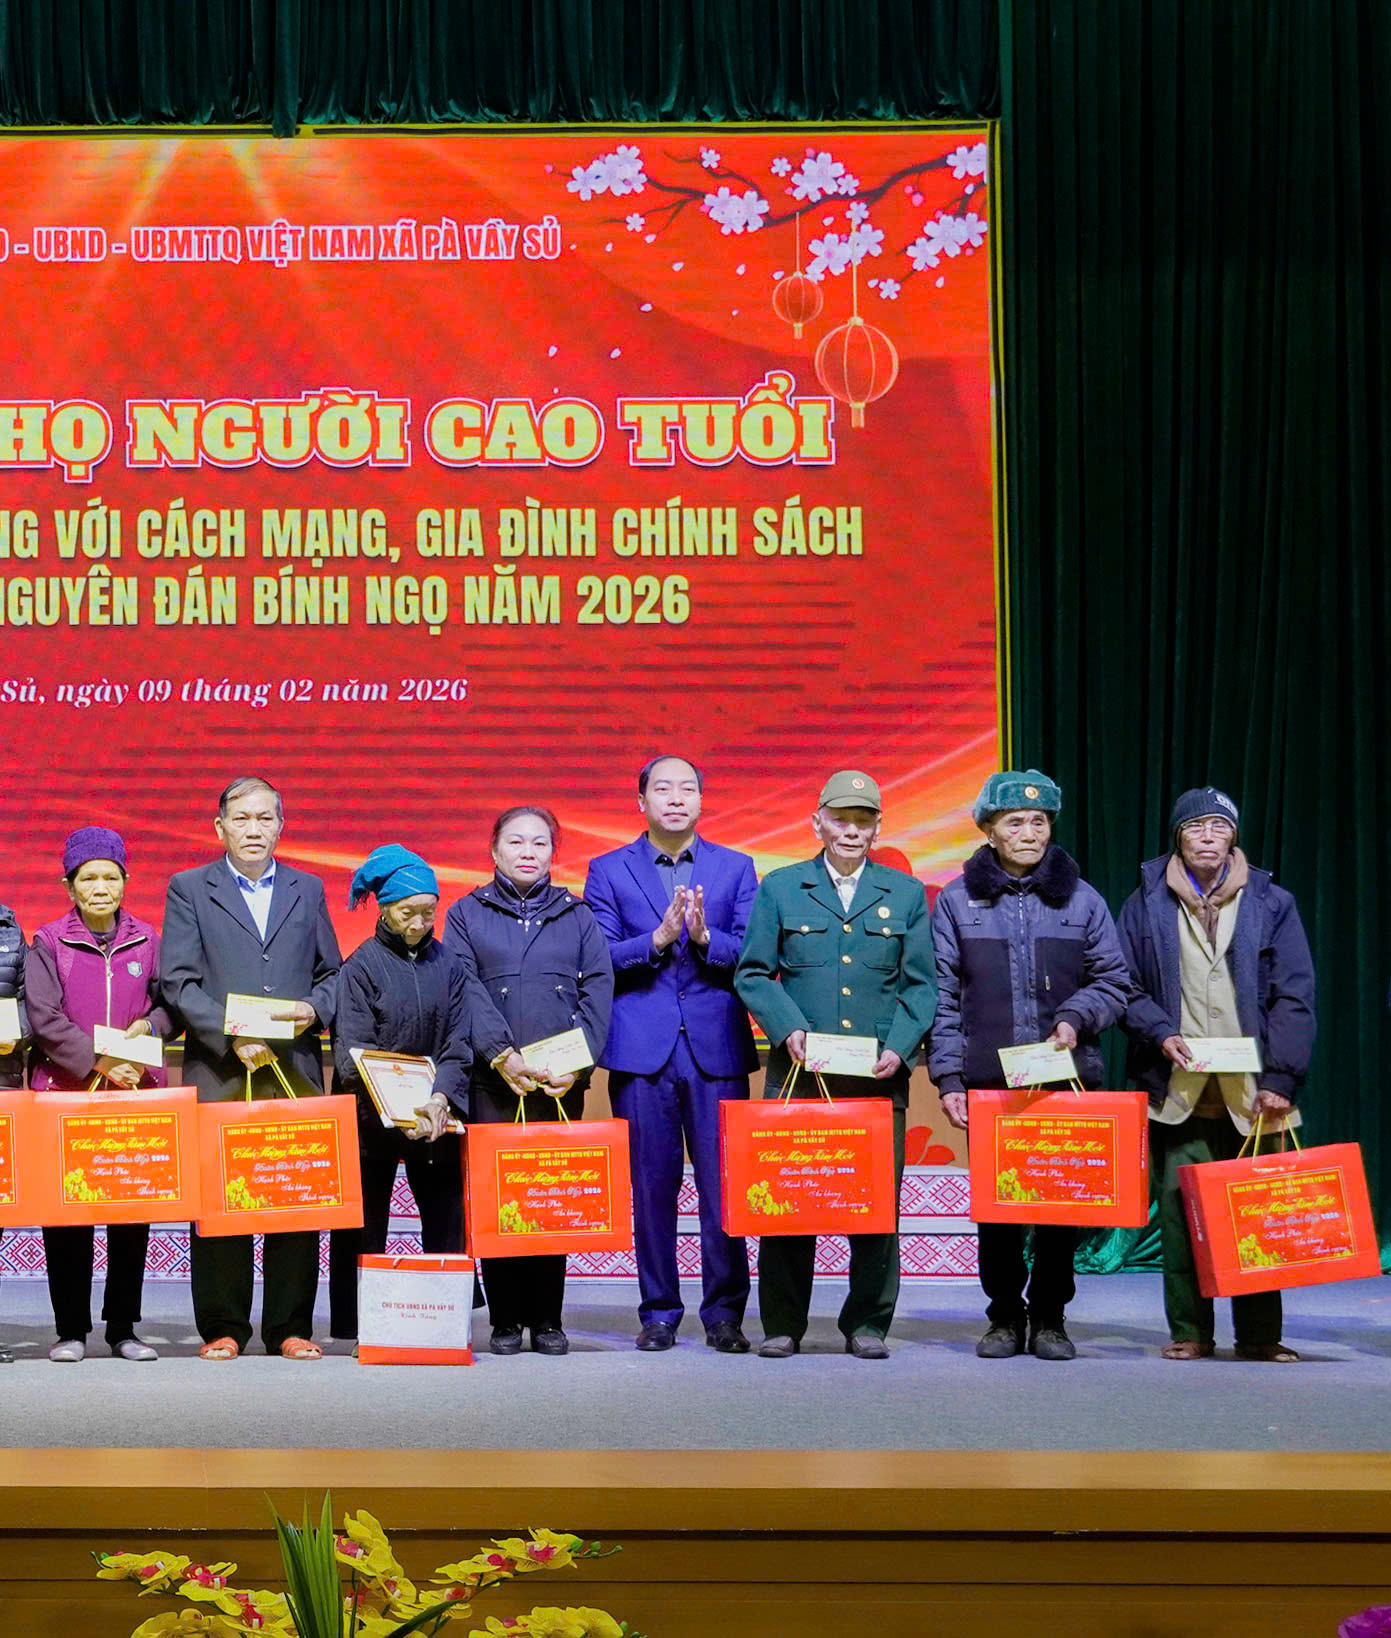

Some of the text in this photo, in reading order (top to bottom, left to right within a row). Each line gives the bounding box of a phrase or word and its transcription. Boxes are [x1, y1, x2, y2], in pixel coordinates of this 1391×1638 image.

[33, 226, 107, 262] UBND
[130, 226, 242, 264] UBMTTQ
[245, 217, 305, 267] VIỆT
[309, 225, 374, 261] NAM
[378, 218, 418, 261] XÃ
[422, 216, 459, 261] PÀ
[464, 217, 519, 261] VẦY
[522, 215, 561, 260] SỦ
[125, 387, 411, 468] NGƯỜI
[426, 398, 605, 467] CAO
[617, 370, 835, 467] TUỔI
[54, 495, 122, 559] VỚI
[136, 494, 246, 559] CÁCH
[262, 508, 400, 568] MẠNG,
[416, 508, 485, 558] GIA
[498, 496, 597, 557] ĐÌNH
[612, 495, 738, 557] CHÍNH
[753, 495, 864, 556] SÁCH
[152, 564, 237, 626] ĐÁN
[253, 565, 348, 625] BÍNH
[365, 576, 448, 635] NGỌ
[464, 564, 561, 624] NĂM
[577, 575, 691, 625] 2026
[0, 677, 46, 705] Sủ,
[56, 680, 130, 707] ngày
[137, 679, 172, 702] 09
[180, 677, 271, 707] tháng
[278, 679, 313, 702] 02
[321, 678, 389, 702] năm
[397, 678, 469, 702] 2026
